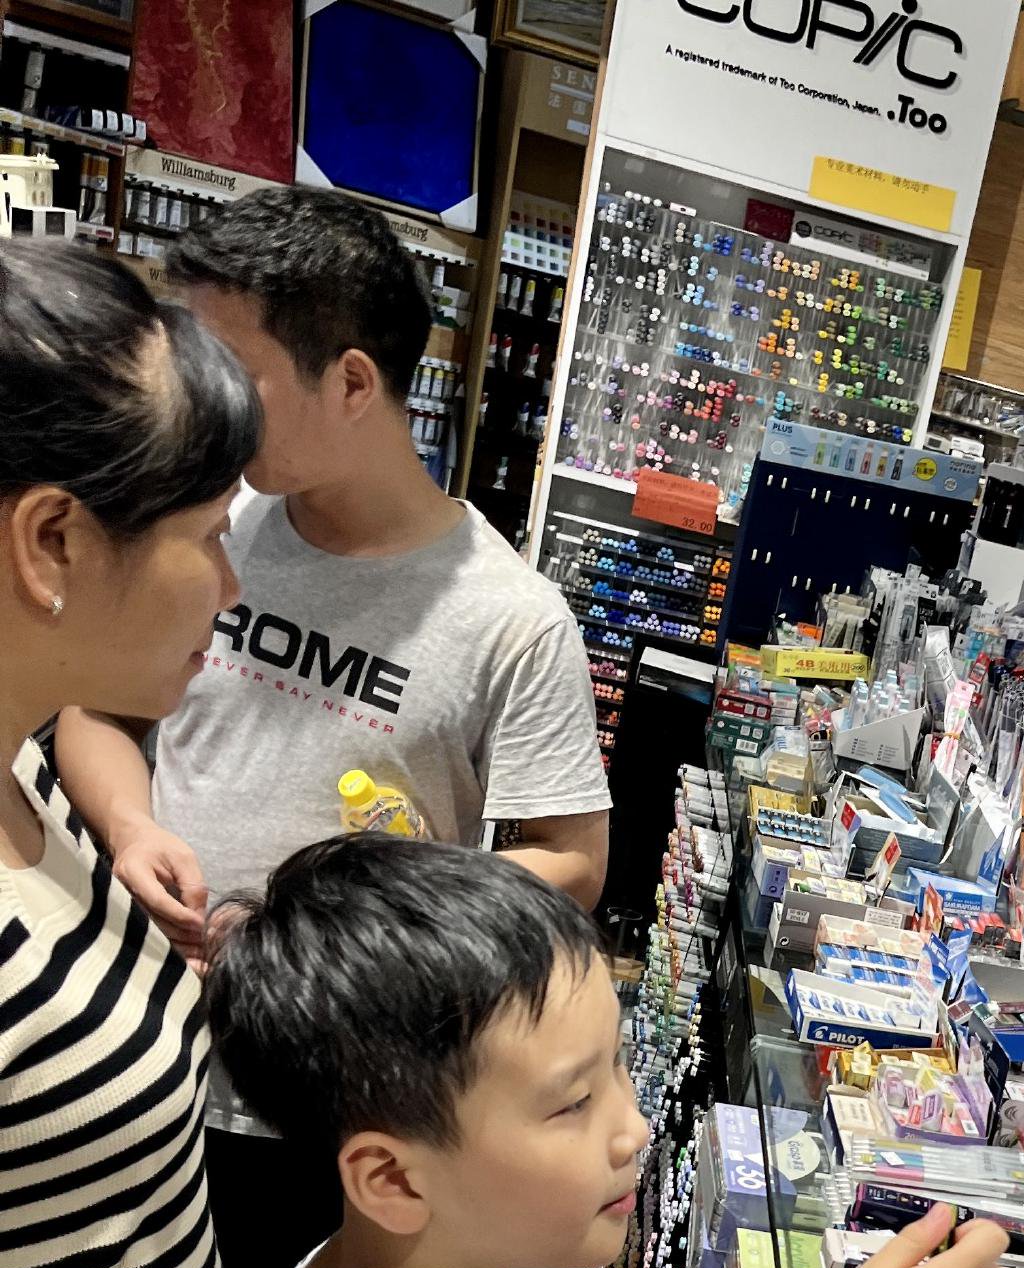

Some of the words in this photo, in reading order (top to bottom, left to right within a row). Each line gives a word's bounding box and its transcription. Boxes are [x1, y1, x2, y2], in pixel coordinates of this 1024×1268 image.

[665, 44, 673, 54] A
[674, 48, 720, 69] registered
[722, 61, 767, 82] trademark
[768, 76, 778, 86] of
[779, 77, 796, 92] Too
[161, 157, 237, 191] Williamsburg
[389, 221, 428, 242] msburg
[772, 423, 793, 433] PLUS
[682, 517, 713, 532] 32.00
[213, 603, 411, 715] ROME
[275, 680, 313, 700] SAY
[321, 700, 395, 735] NEVER
[828, 1032, 865, 1044] PILOT
